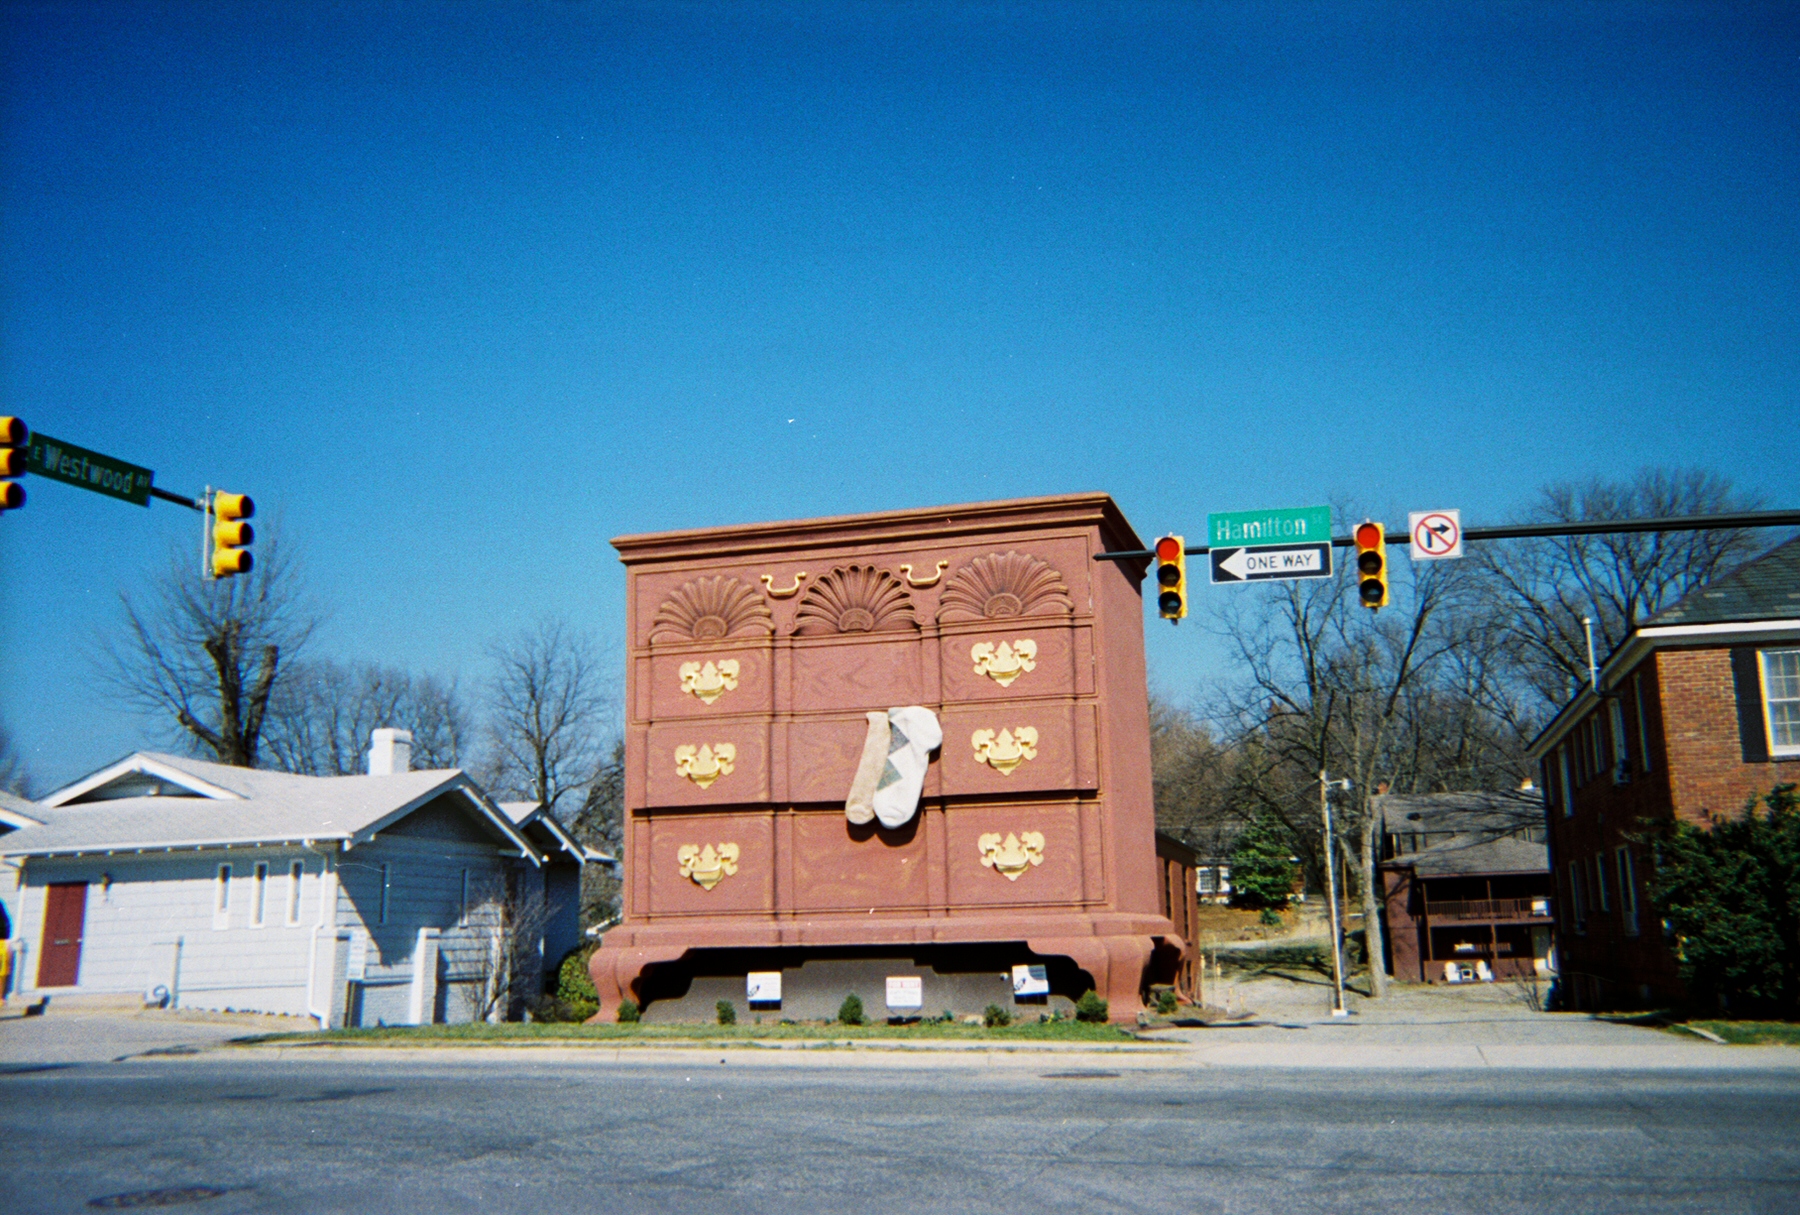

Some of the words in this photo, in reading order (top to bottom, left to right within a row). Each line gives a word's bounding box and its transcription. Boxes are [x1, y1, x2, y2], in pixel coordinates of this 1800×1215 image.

[45, 444, 133, 493] Westwood
[1217, 517, 1306, 541] Hamilton
[1246, 555, 1278, 571] ONE
[1283, 553, 1313, 567] WAY
